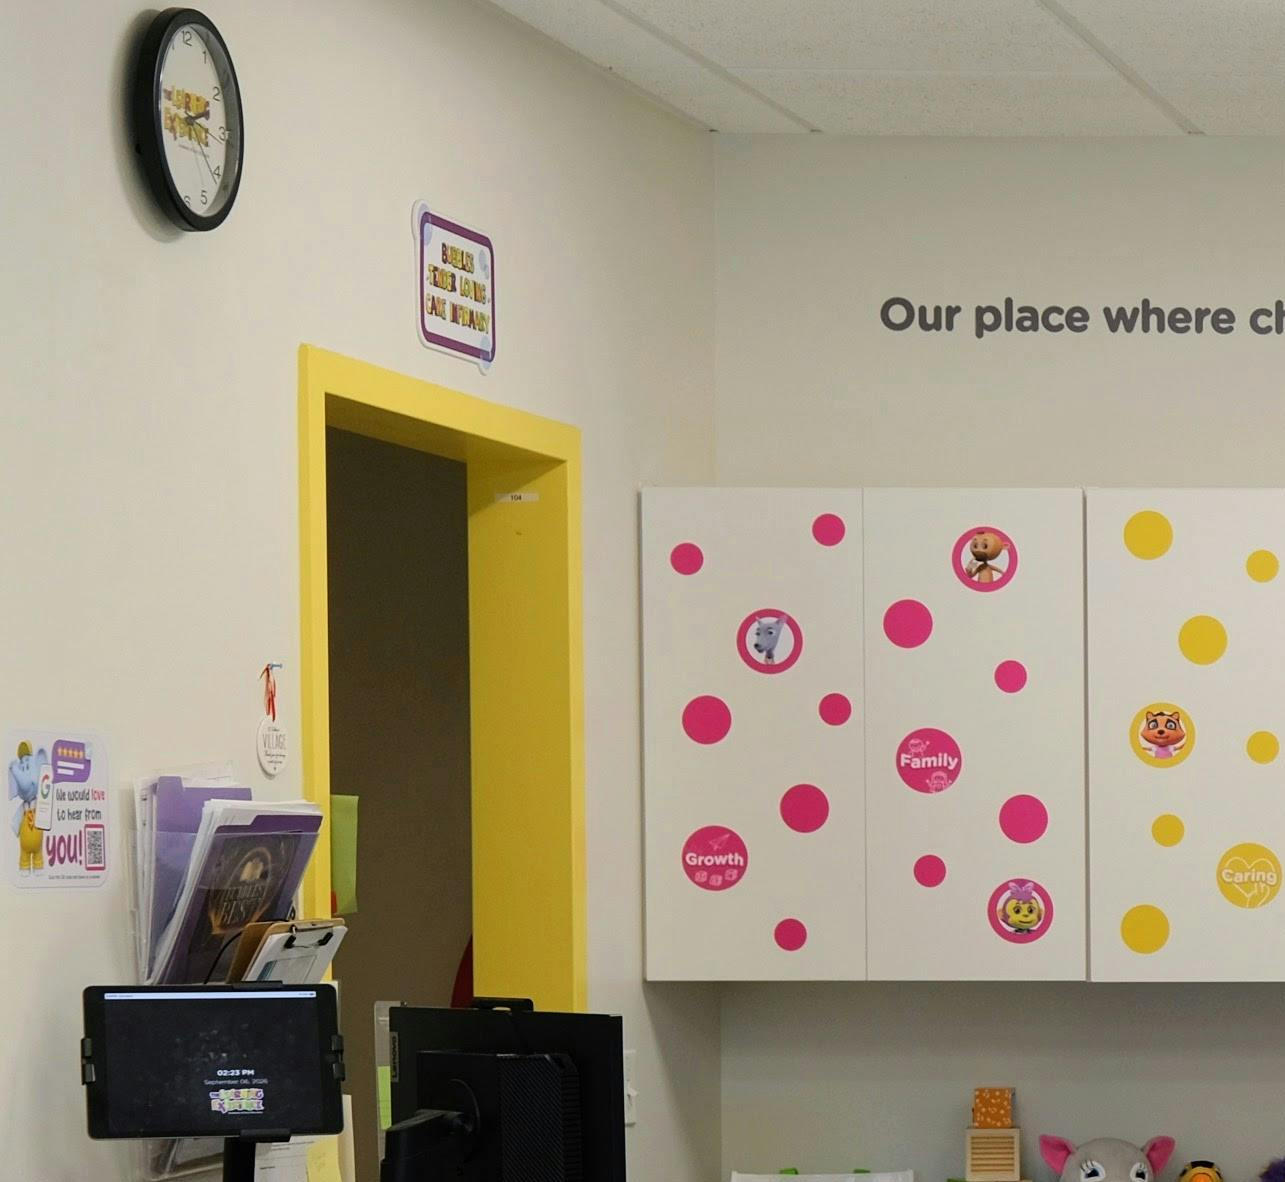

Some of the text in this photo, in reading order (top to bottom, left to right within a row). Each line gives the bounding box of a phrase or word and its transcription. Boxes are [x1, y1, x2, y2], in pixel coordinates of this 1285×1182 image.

[181, 30, 192, 46] 12
[212, 86, 220, 101] 2
[218, 126, 226, 142] 3
[212, 165, 221, 178] 4
[200, 190, 207, 205] 5
[441, 242, 474, 274] BUBBLES
[428, 263, 486, 305] TENDER LOVING
[426, 293, 490, 334] CARE INFIRMARY
[880, 296, 962, 332] Our
[975, 297, 1090, 338] place
[1103, 298, 1236, 335] where
[900, 752, 959, 770] Family
[41, 774, 51, 799] G
[56, 788, 105, 801] We would love
[57, 808, 101, 821] to hear from
[46, 829, 82, 867] you!
[685, 852, 744, 867] Growth
[1221, 868, 1278, 886] Caring
